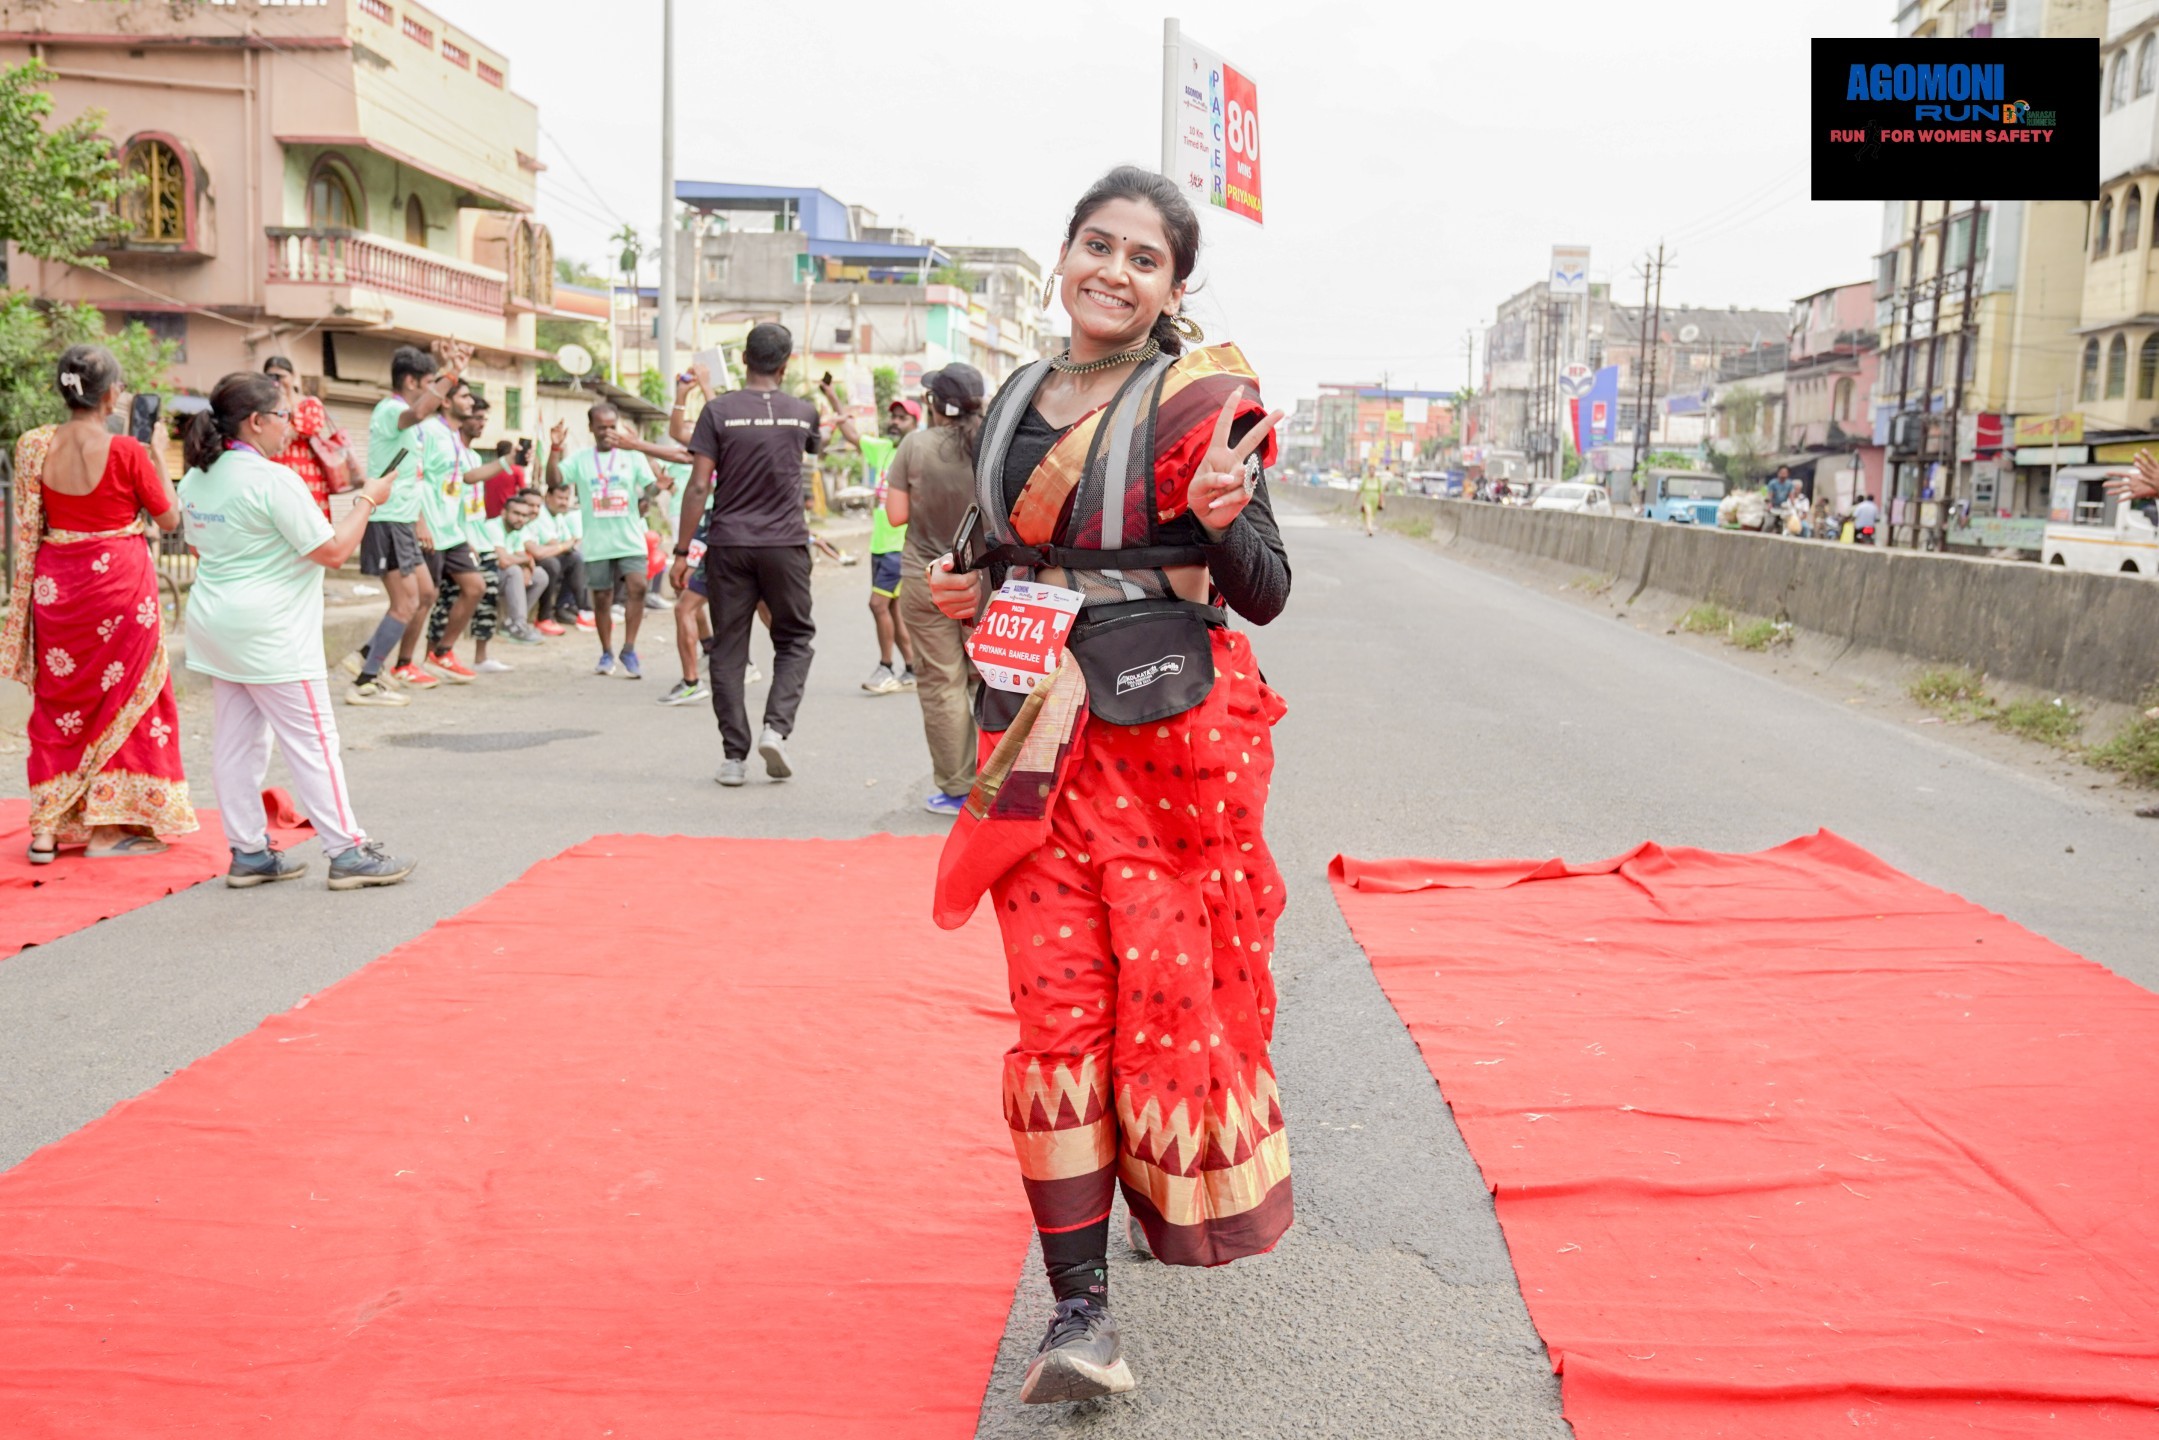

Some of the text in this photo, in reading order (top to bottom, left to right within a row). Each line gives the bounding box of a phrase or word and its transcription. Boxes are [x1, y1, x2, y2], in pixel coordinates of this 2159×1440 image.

[1189, 125, 1196, 136] 10
[1212, 70, 1222, 194] PACER
[1227, 100, 1259, 162] 80
[1184, 135, 1210, 154] Timed Run
[1237, 161, 1252, 179] MINS
[1227, 184, 1262, 212] PRIYANKA
[1569, 366, 1587, 377] HP
[725, 418, 752, 427] FAMILY
[754, 418, 774, 426] CLUB
[1011, 605, 1026, 614] PACER
[987, 611, 1045, 644] 10374
[978, 643, 1041, 664] PRIYANKA BANERJEE
[1126, 669, 1152, 681] KOLKATA
